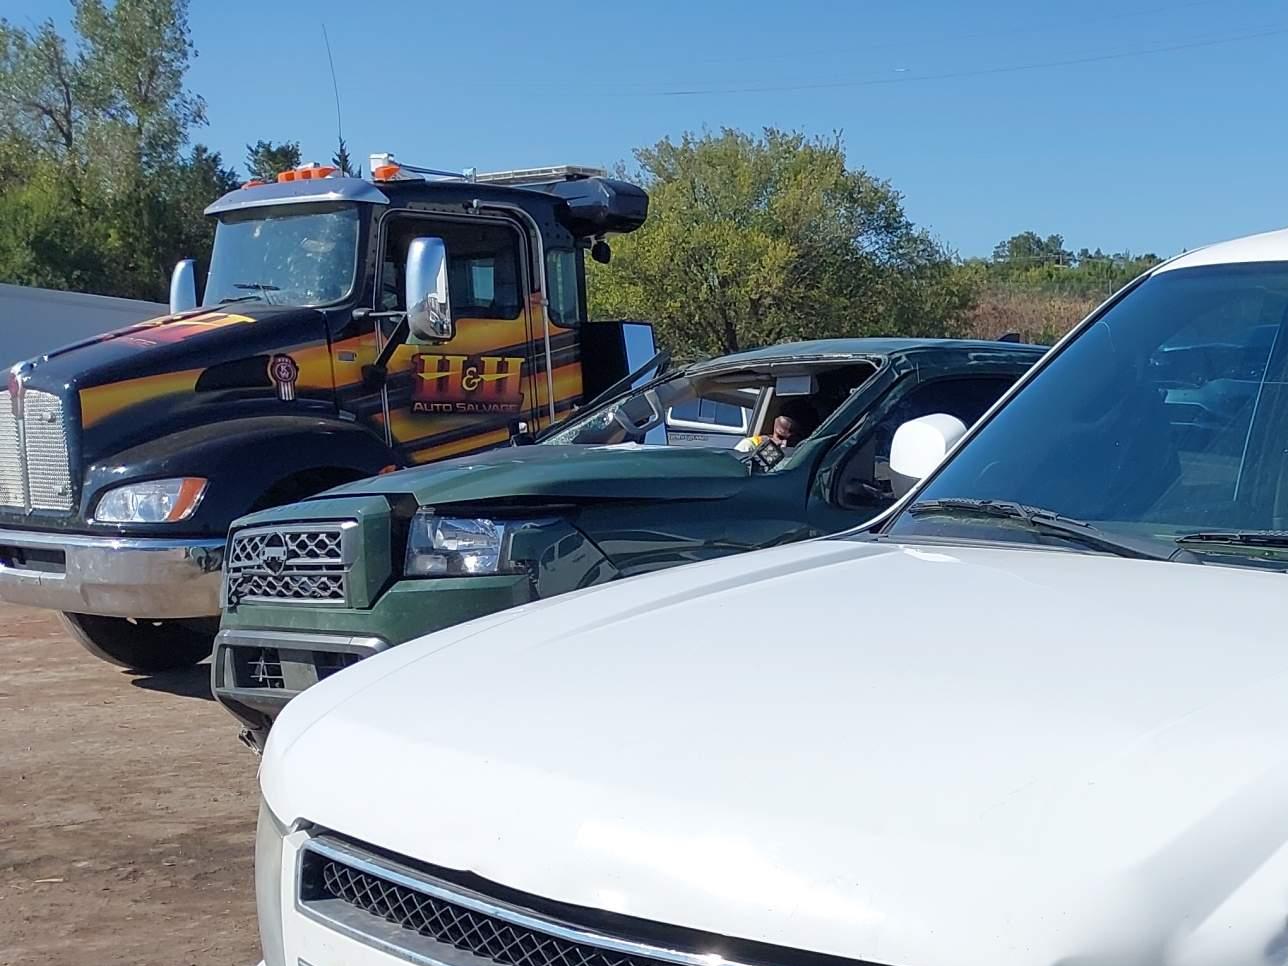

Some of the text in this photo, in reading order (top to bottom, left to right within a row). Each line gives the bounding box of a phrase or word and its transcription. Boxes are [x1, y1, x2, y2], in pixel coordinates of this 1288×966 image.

[417, 355, 526, 396] H&H
[413, 402, 520, 412] AUTO SALVAGE
